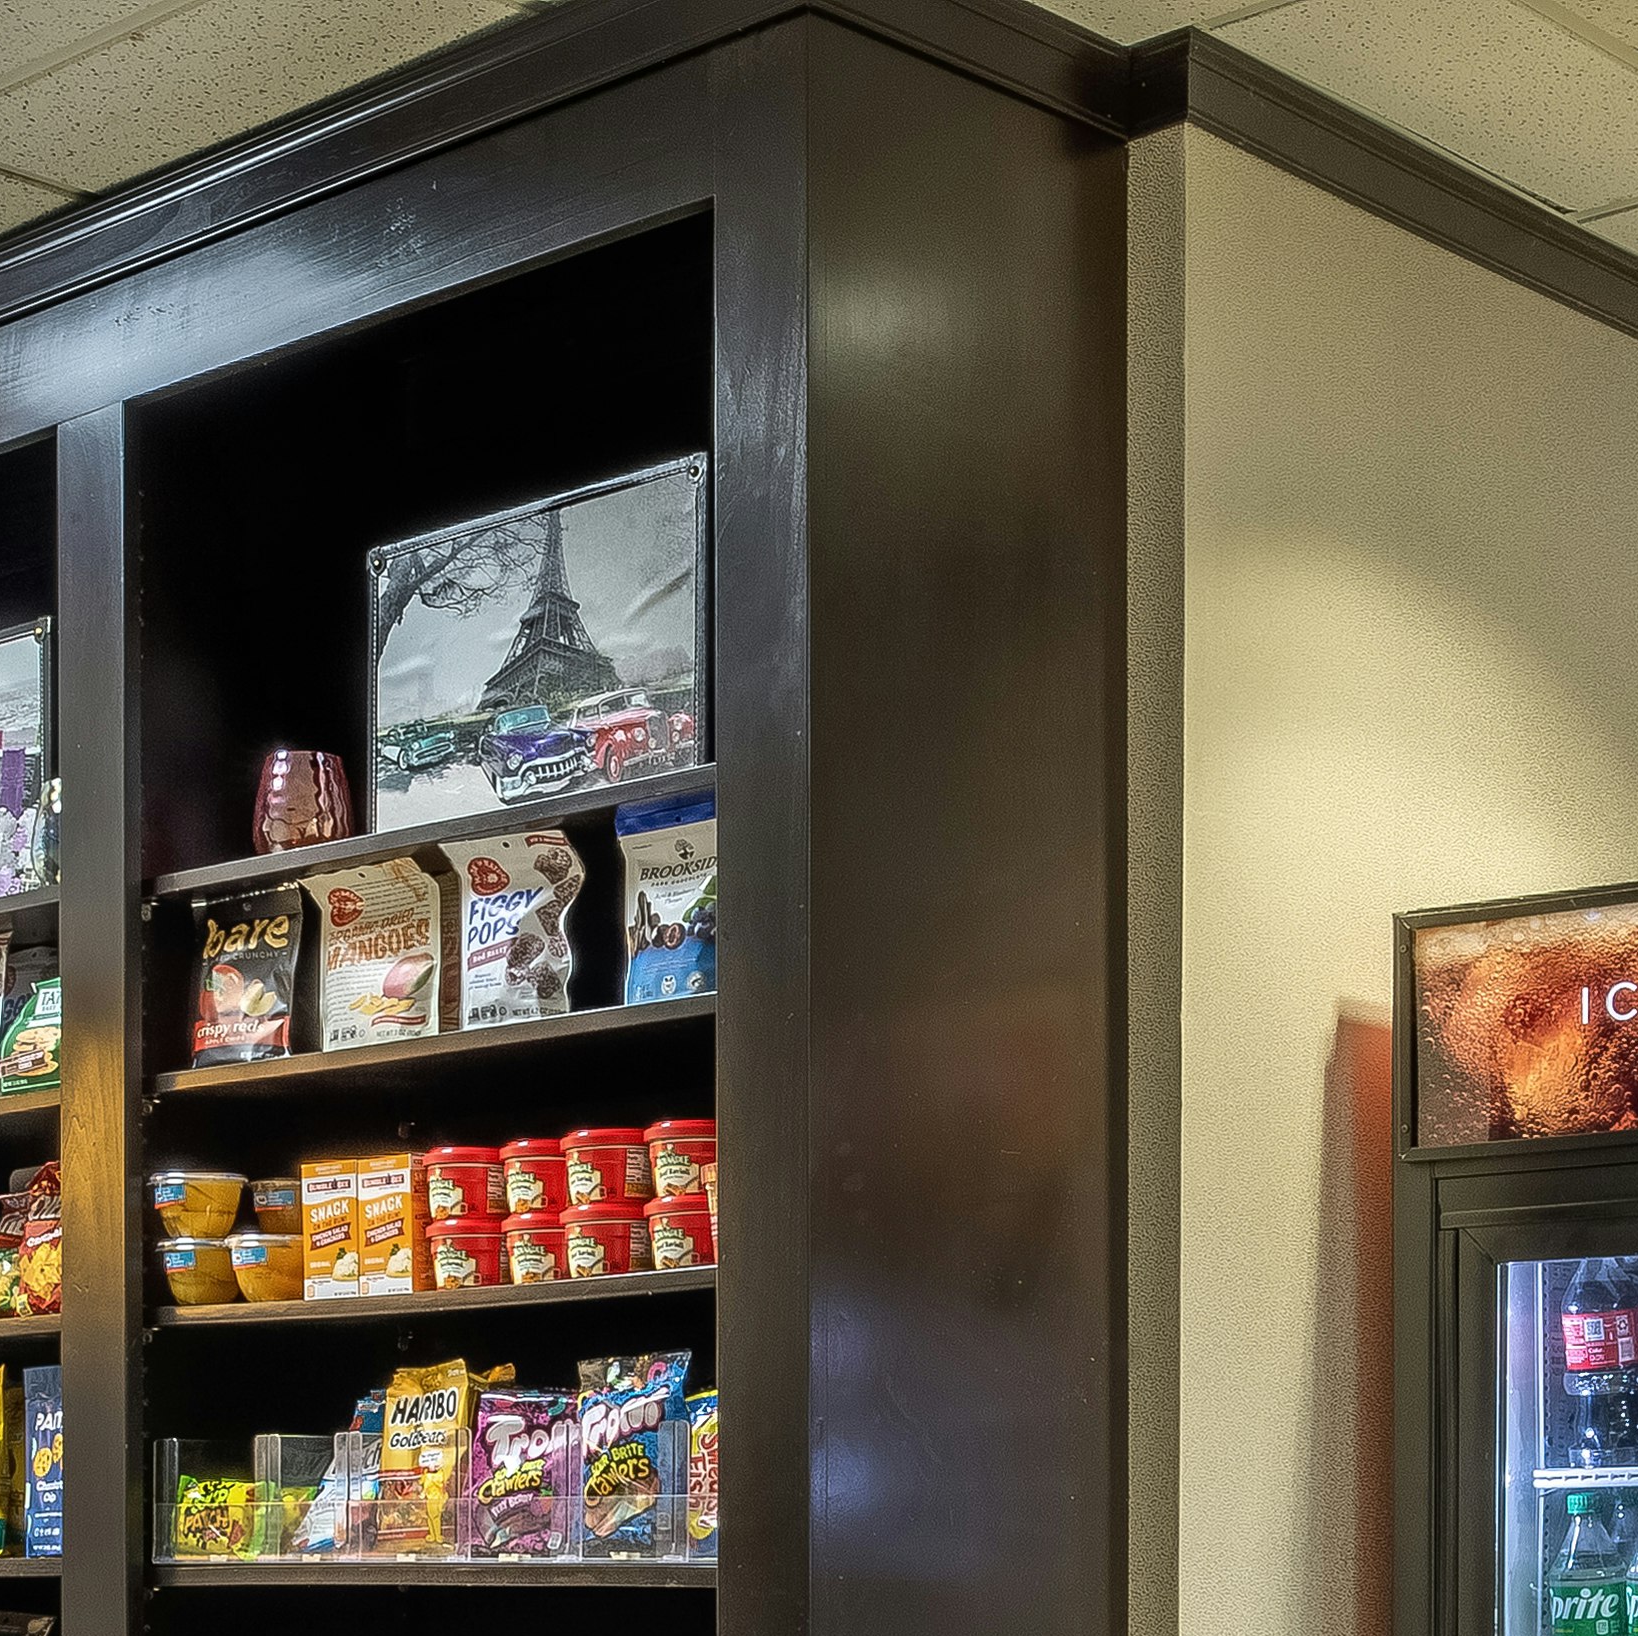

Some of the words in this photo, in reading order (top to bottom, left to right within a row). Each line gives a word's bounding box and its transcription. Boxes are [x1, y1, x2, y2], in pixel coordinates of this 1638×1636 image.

[469, 887, 544, 925] FIGGY
[202, 915, 290, 960] bare
[468, 917, 520, 948] POPS
[197, 1022, 231, 1039] crispy
[232, 1020, 265, 1034] reds
[309, 1199, 350, 1222] SNACK
[364, 1193, 404, 1220] SNACK
[390, 1386, 459, 1428] HARIBO
[611, 1442, 644, 1462] BRITE
[1550, 1586, 1619, 1625] prite
